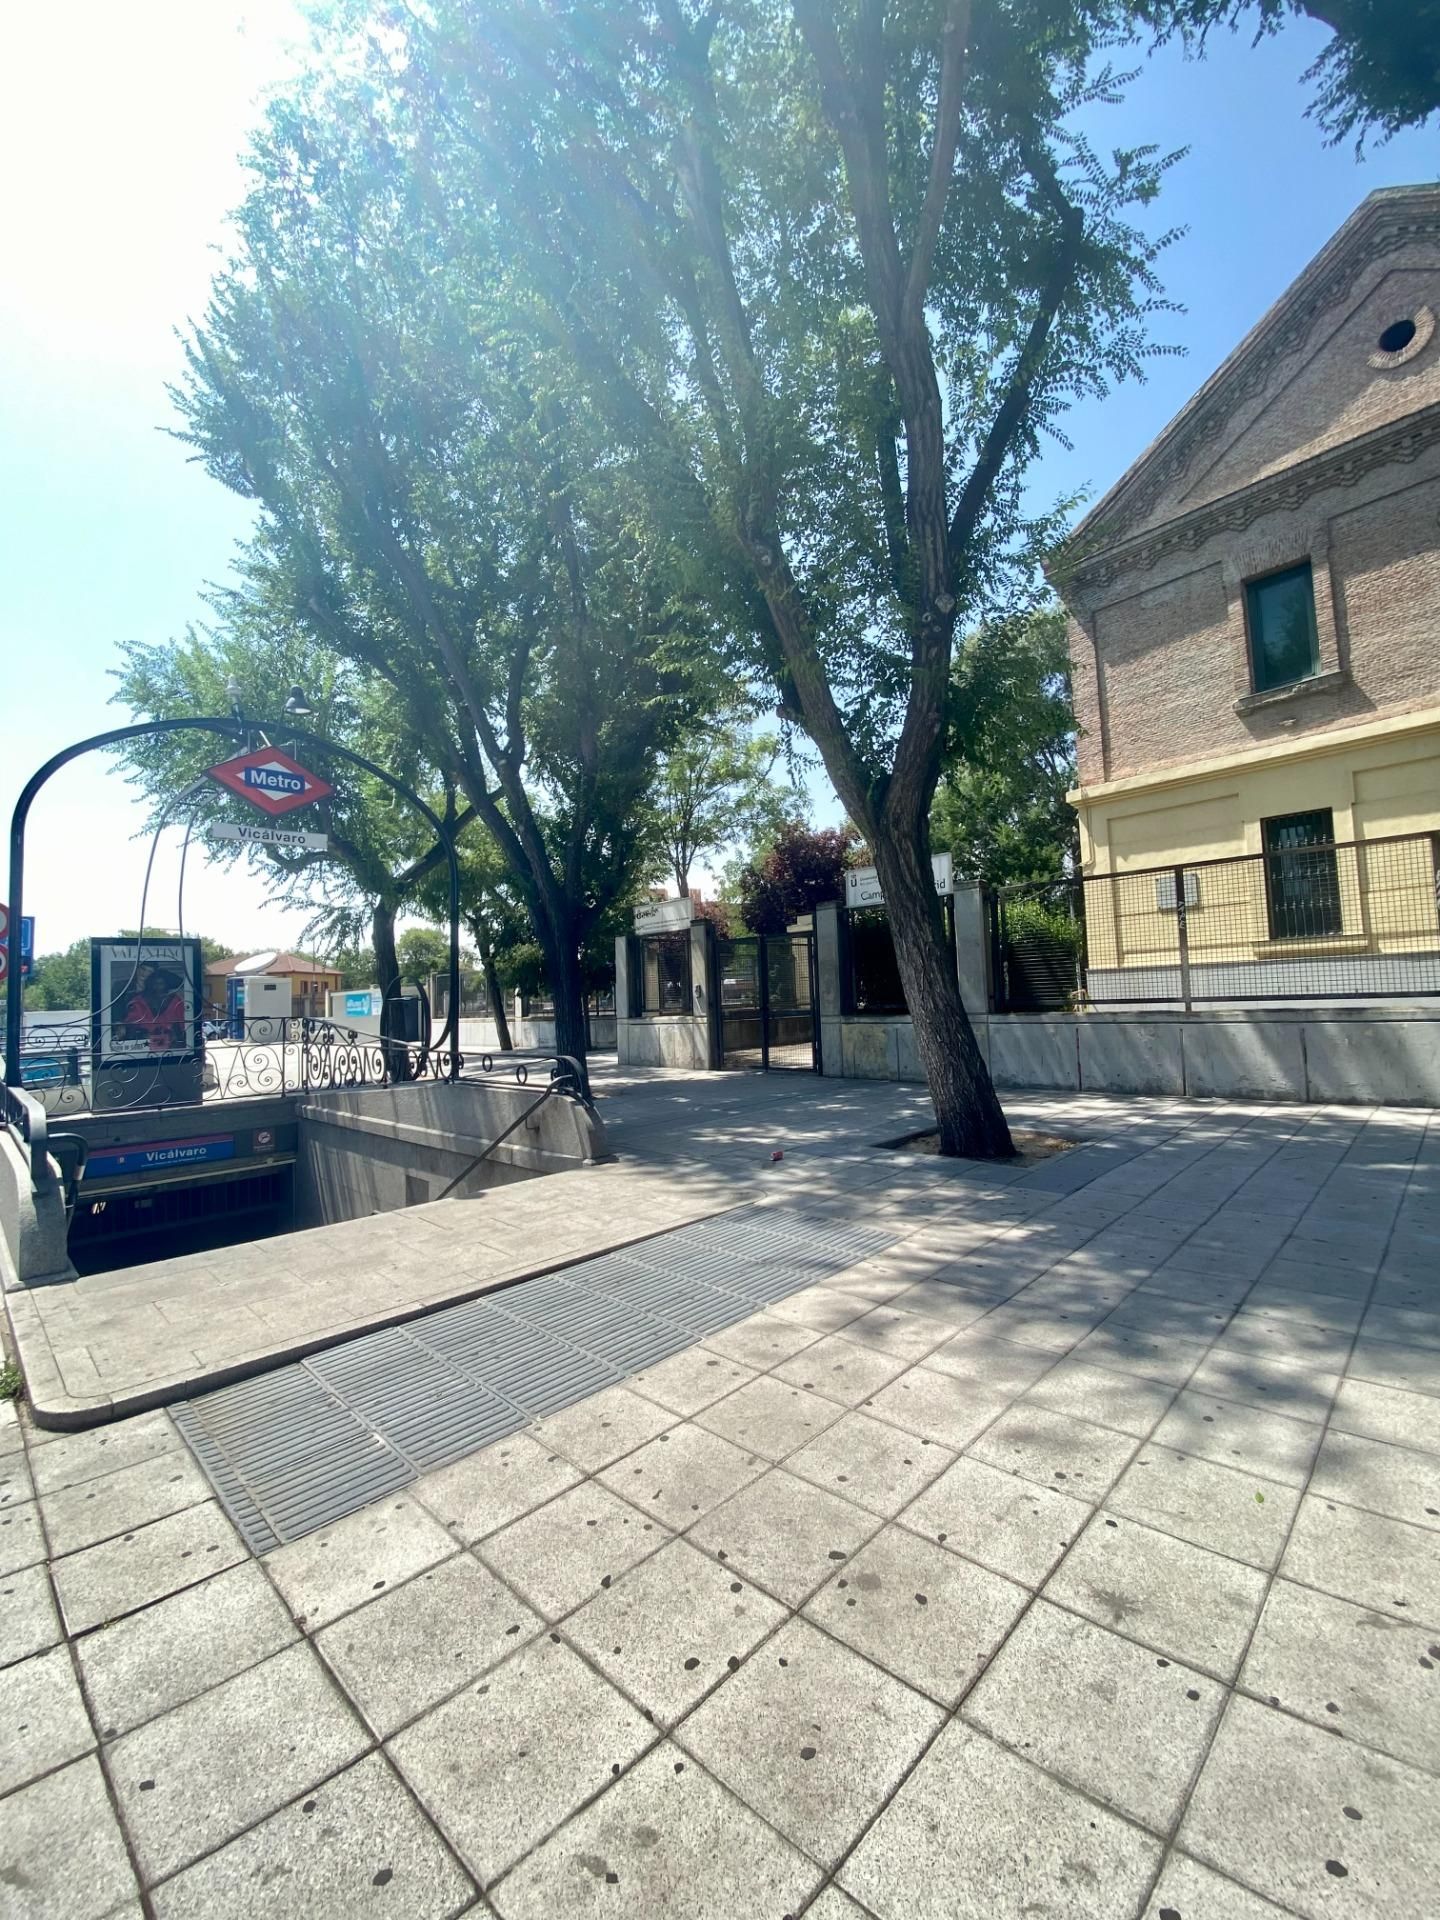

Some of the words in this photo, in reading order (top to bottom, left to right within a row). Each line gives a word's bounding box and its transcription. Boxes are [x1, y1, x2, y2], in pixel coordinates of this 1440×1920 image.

[250, 770, 301, 790] Metro
[238, 827, 306, 844] Vicálvaro
[146, 1147, 207, 1162] Vicálvaro
